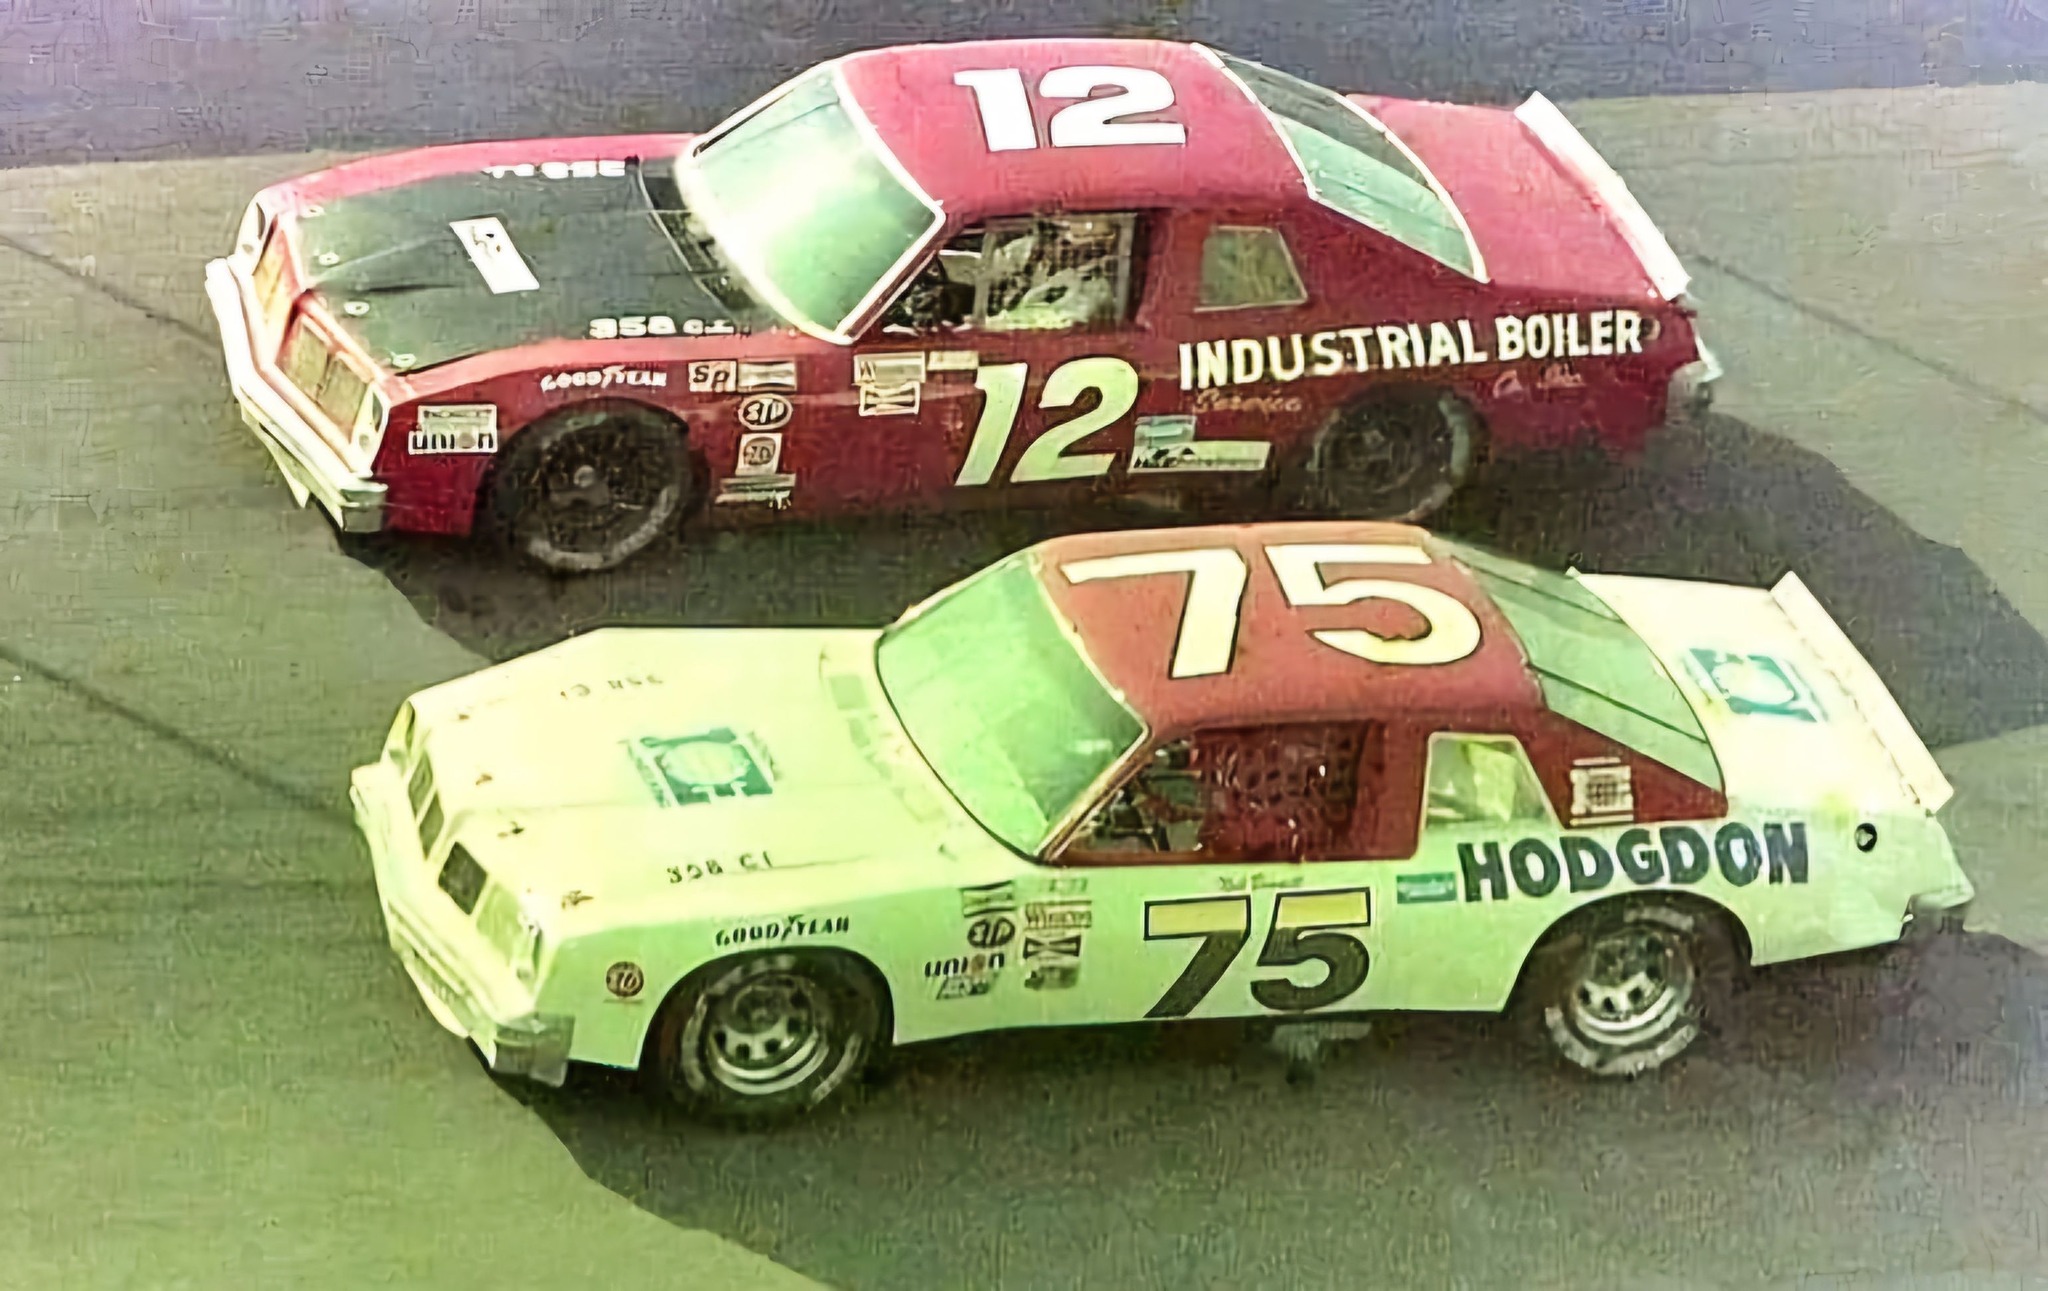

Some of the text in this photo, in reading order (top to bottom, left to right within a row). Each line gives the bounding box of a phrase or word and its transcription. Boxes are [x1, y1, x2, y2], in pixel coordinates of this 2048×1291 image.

[953, 65, 1187, 152] 12
[1180, 317, 1488, 391] INDUSTRIAL
[1497, 309, 1643, 361] BOILER
[953, 357, 1139, 486] 12
[1063, 545, 1482, 680] 75
[1456, 821, 1810, 903] HODGDON
[1142, 885, 1372, 1020] 75
